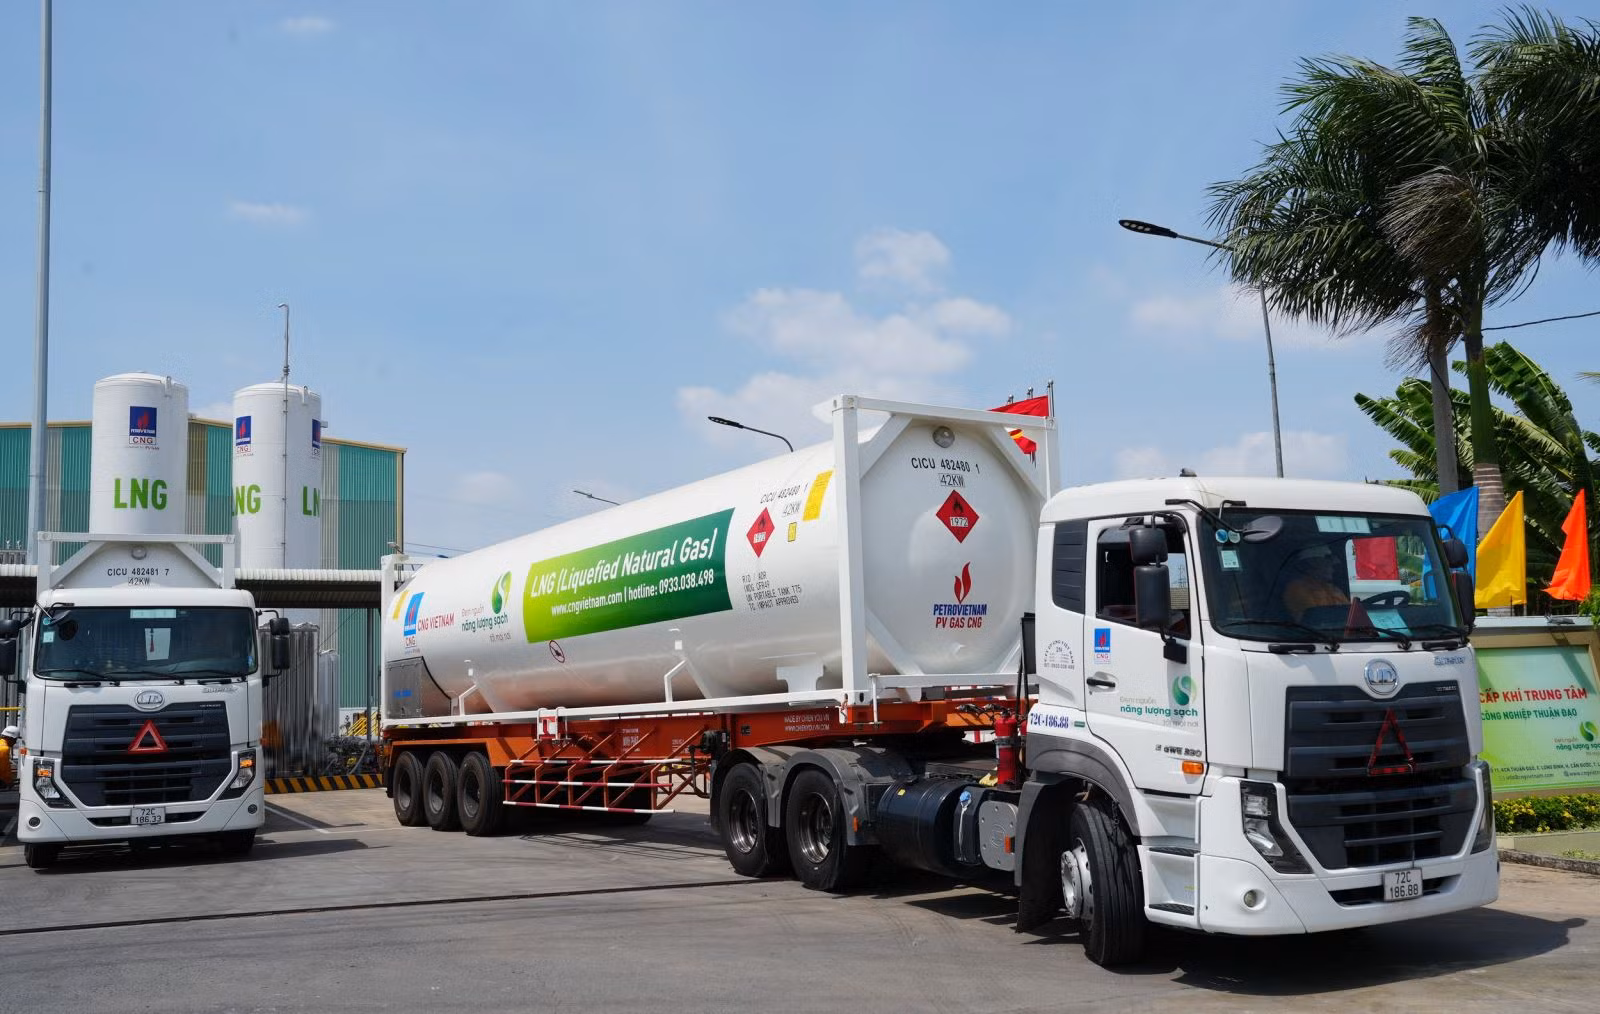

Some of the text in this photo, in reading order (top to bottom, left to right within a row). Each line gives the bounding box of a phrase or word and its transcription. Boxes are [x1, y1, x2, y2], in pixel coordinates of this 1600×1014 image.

[132, 436, 153, 444] CNG
[911, 457, 980, 474] CICU 482480 1
[940, 474, 965, 487] 42KW
[113, 478, 168, 511] LNG
[232, 484, 262, 517] NG
[950, 517, 969, 527] 1972
[530, 528, 718, 599] LNG (Liquefied Natural Gas)
[107, 567, 170, 576] CICU 482481 7
[551, 591, 622, 615] www.cngvietnam.com
[627, 582, 658, 600] hotline:
[659, 568, 714, 592] 0933.038.498
[753, 588, 777, 601] PORTABLE
[933, 604, 987, 616] PETROVIETNAM
[417, 612, 455, 631] CNG VIETNAM
[935, 617, 982, 628] PV GAS CNG
[1479, 684, 1588, 704] CẤP KHÍ TRUNG TÂM
[1120, 705, 1198, 719] năng lượng sạch
[1503, 708, 1532, 720] NGHIỆP
[1533, 706, 1560, 720] THUẬN
[1561, 708, 1578, 719] ĐẠO
[1030, 713, 1069, 728] 72C-186.88
[141, 808, 156, 816] 72C
[136, 815, 162, 824] 186.33
[1395, 871, 1412, 884] 72C
[1390, 884, 1419, 899] 186.88
